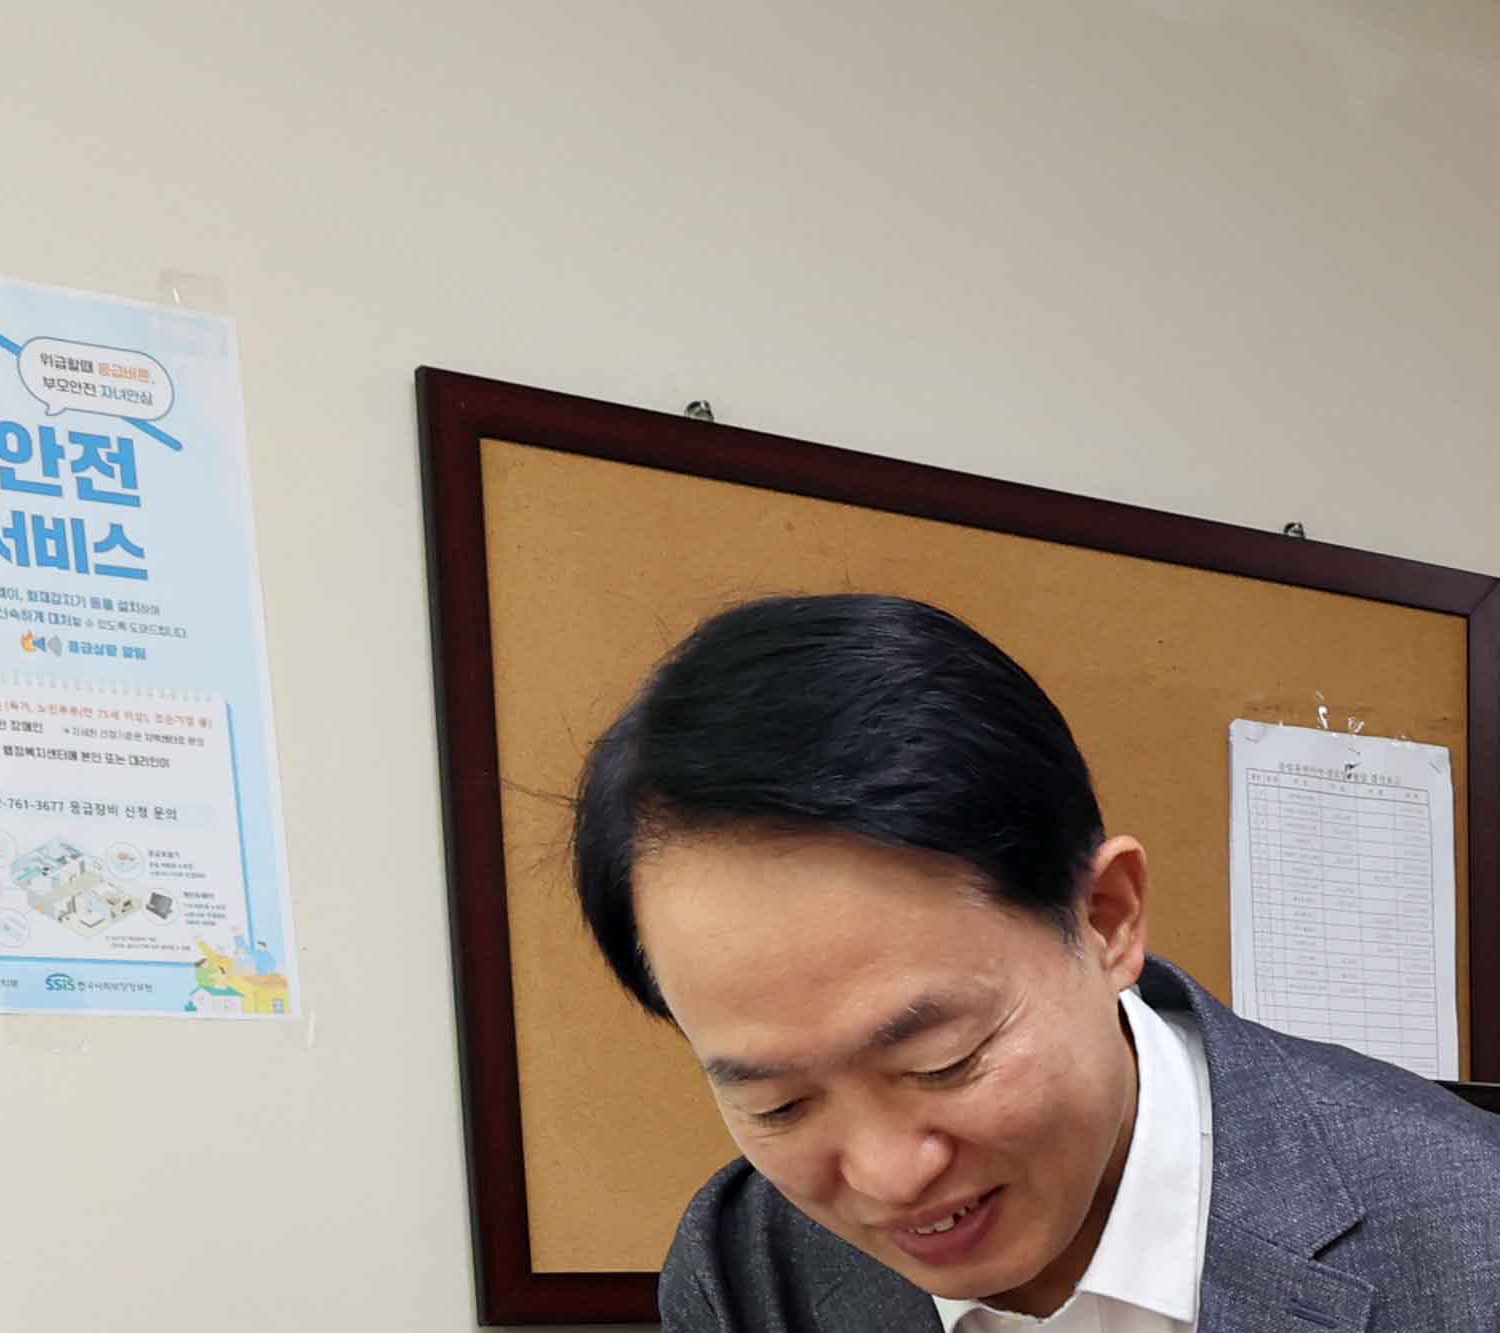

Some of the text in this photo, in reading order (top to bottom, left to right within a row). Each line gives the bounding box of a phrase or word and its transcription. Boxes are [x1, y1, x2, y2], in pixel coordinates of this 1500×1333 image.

[40, 352, 94, 373] 위급할때
[43, 376, 153, 406] 부모안전 자녀안심
[9, 720, 44, 734] 장애인
[81, 751, 102, 764] 본인
[105, 753, 125, 766] 또는
[128, 755, 171, 769] 대리인이
[69, 800, 119, 817] 응급장비
[124, 805, 148, 819] 신청
[153, 806, 177, 821] 문의
